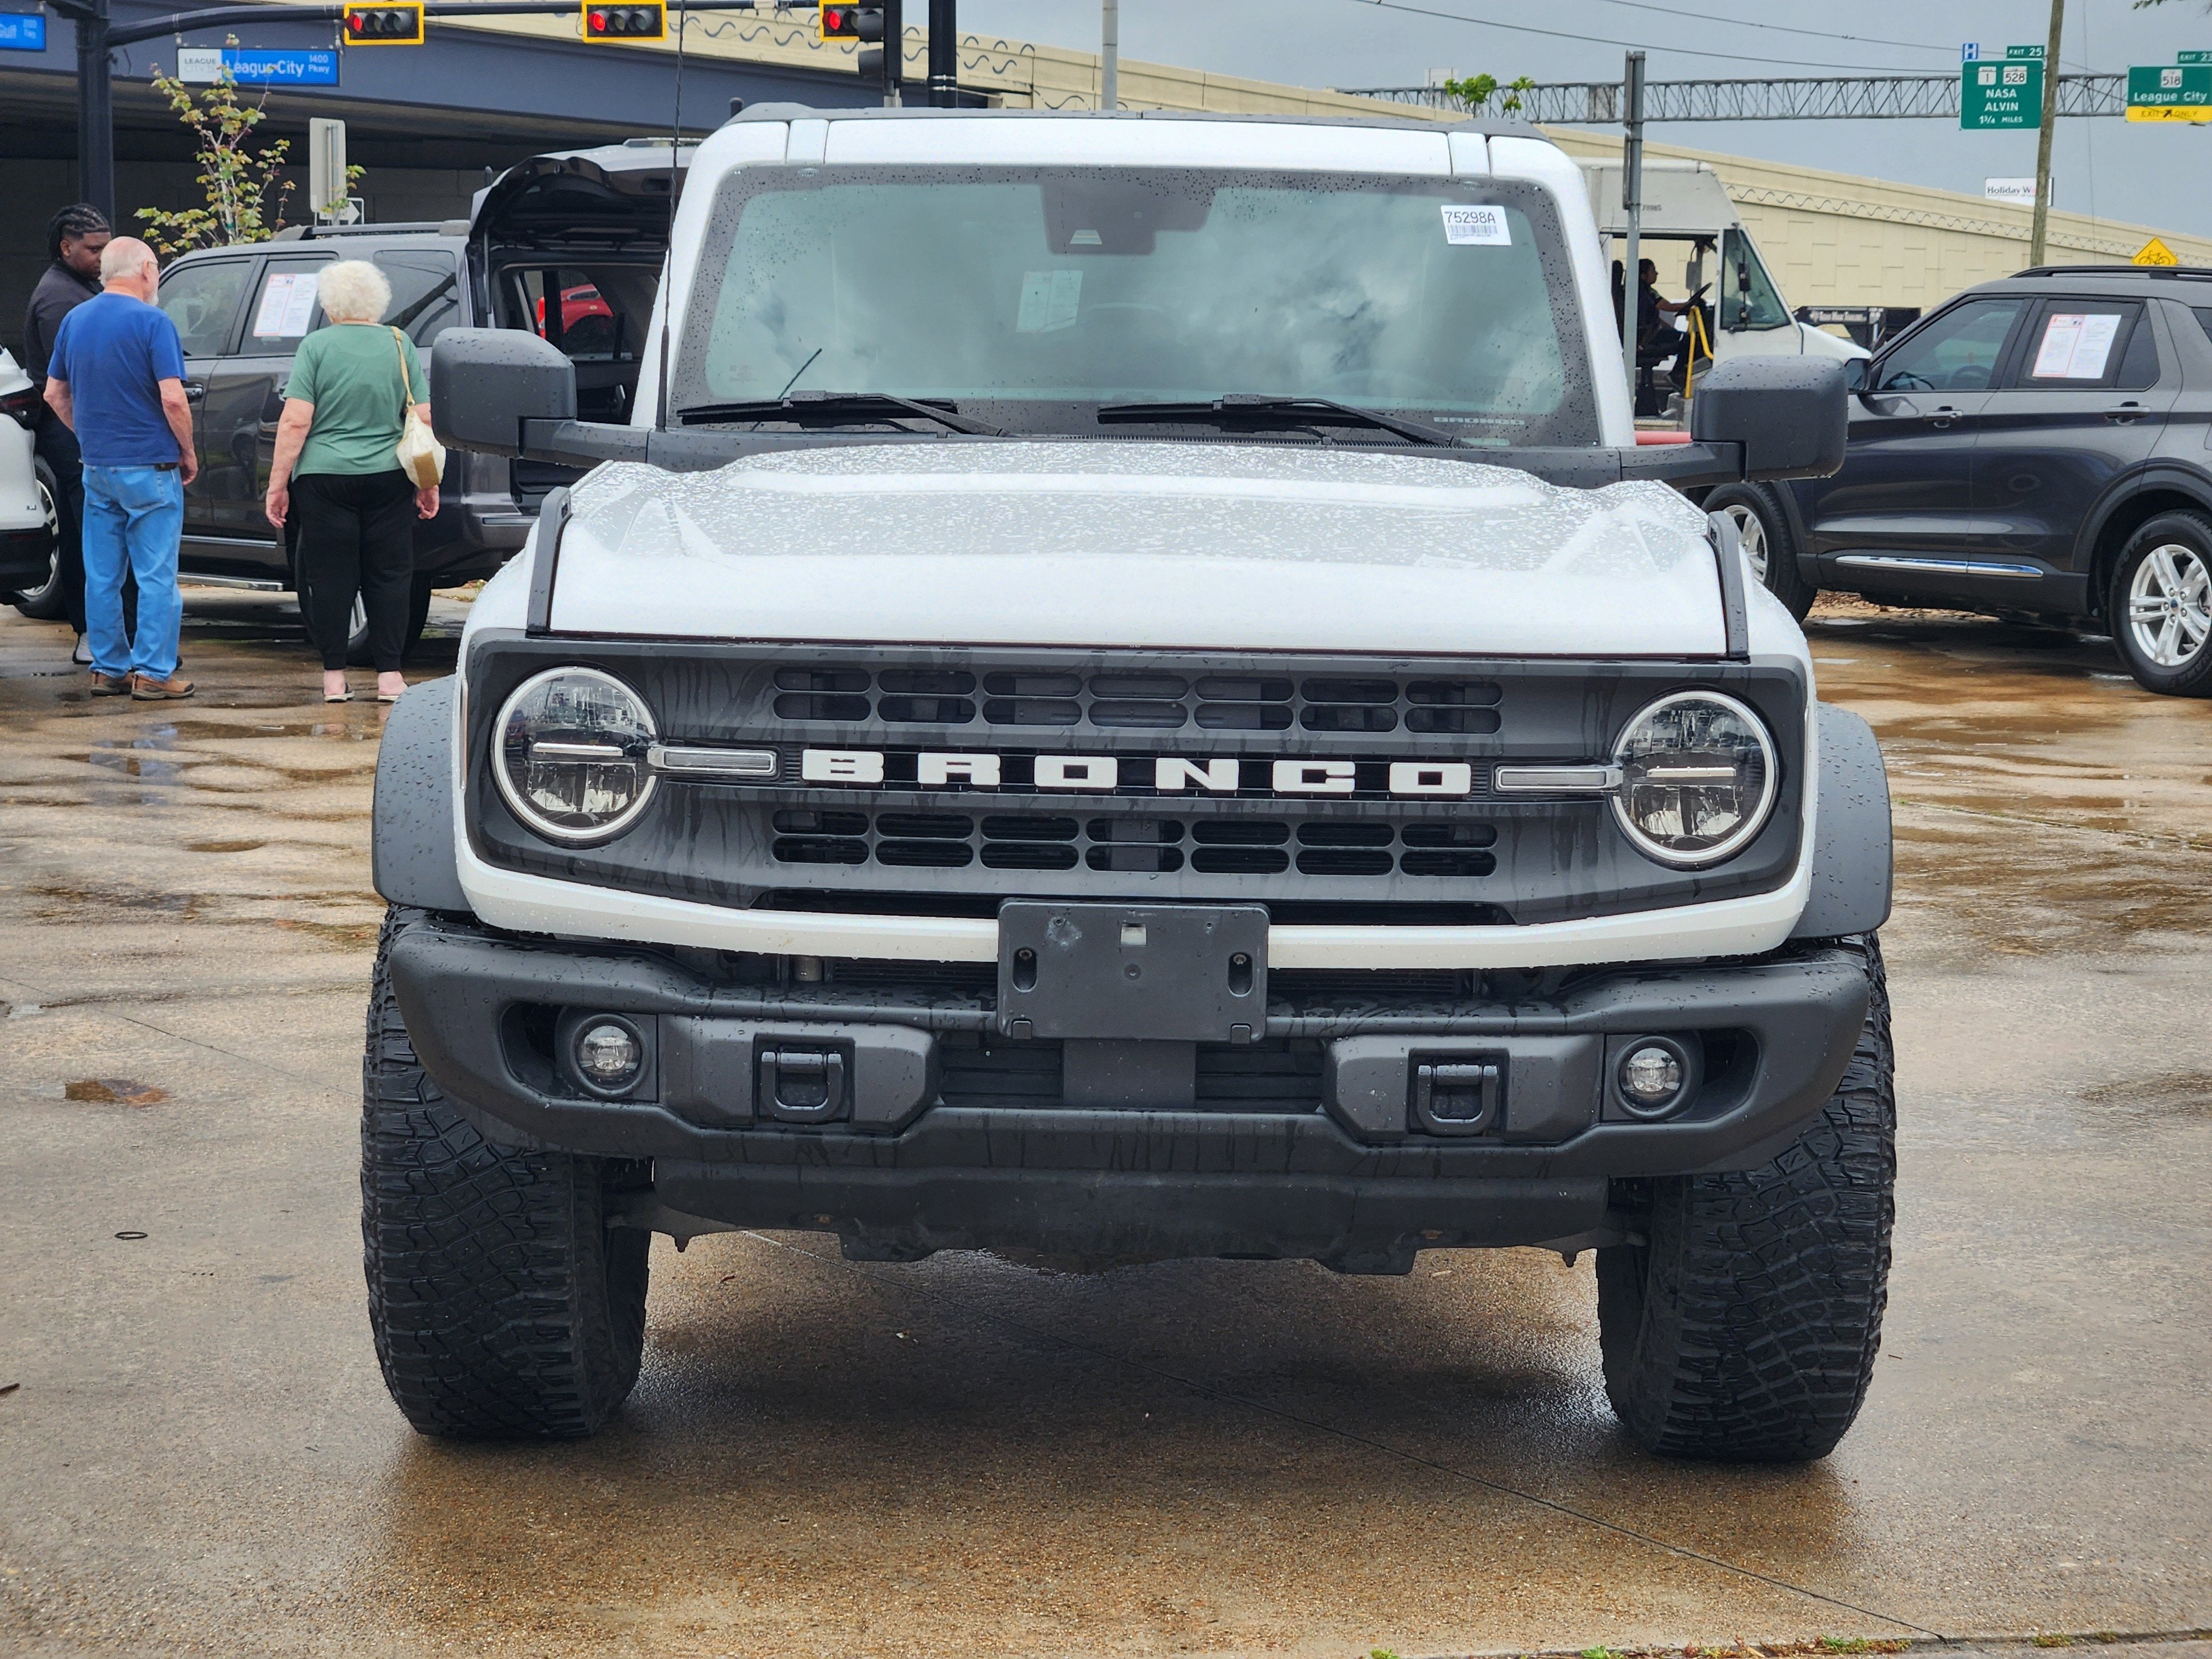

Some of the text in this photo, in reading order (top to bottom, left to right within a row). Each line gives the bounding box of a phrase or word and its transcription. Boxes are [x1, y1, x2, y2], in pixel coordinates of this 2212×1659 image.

[2029, 48, 2042, 56] 25
[309, 54, 328, 63] 1400
[276, 60, 304, 77] City
[308, 64, 330, 74] Pkwy
[1986, 74, 1989, 82] 1
[2006, 73, 2025, 82] 528
[2163, 76, 2180, 85] 518
[1986, 88, 2017, 98] NASA
[2133, 91, 2208, 103] League City
[1984, 102, 2018, 112] ALVIN
[1987, 186, 2021, 195] Holiday
[1444, 211, 1496, 223] 75298A
[802, 749, 1470, 794] BRONCO
